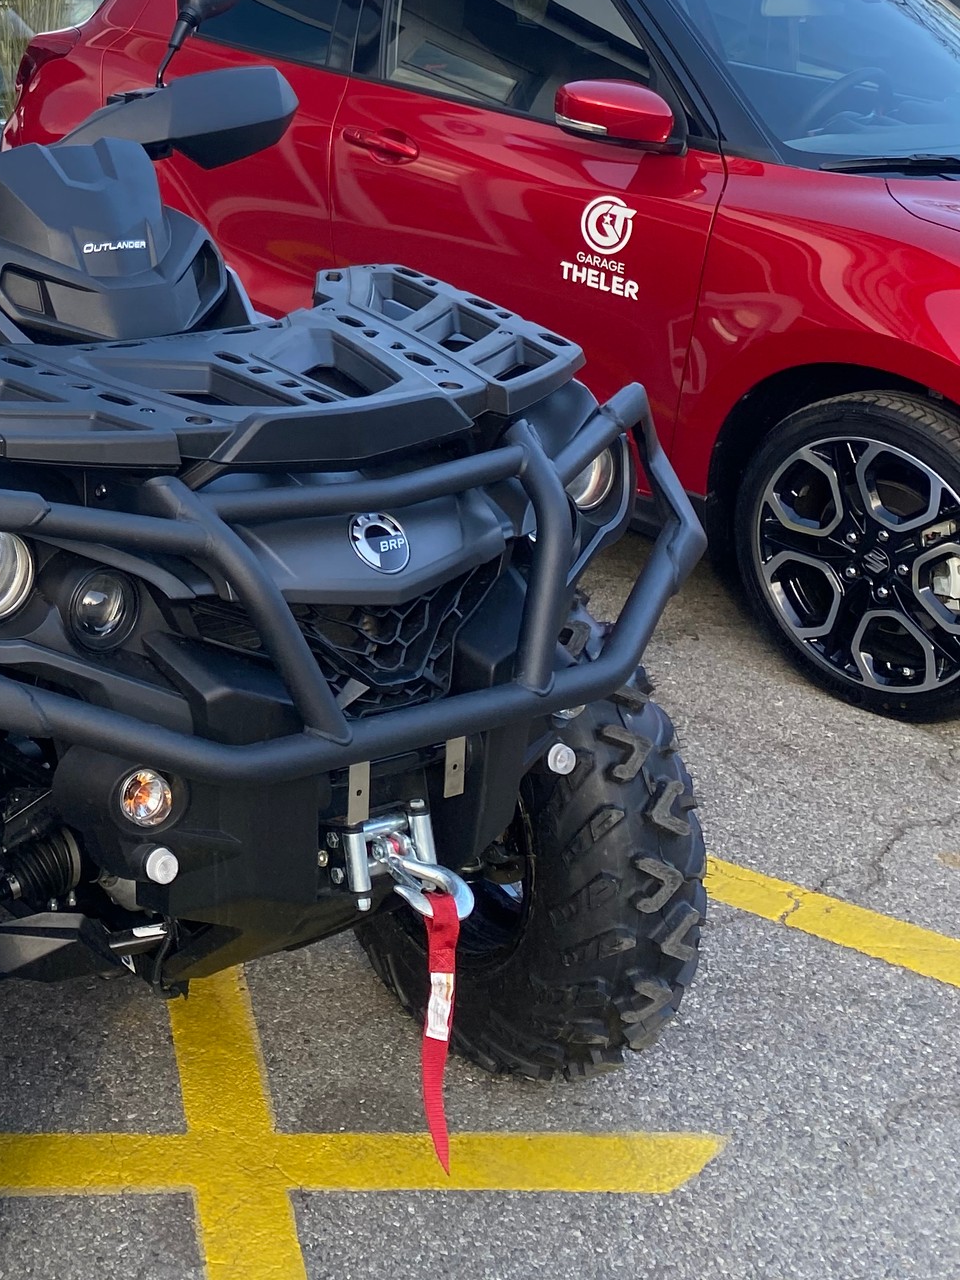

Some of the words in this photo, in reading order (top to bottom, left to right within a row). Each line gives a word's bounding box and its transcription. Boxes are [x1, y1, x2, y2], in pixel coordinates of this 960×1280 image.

[83, 240, 146, 254] OUTLANDER
[576, 251, 626, 275] GARAGE
[559, 260, 640, 301] THELER
[380, 537, 405, 553] BRP
